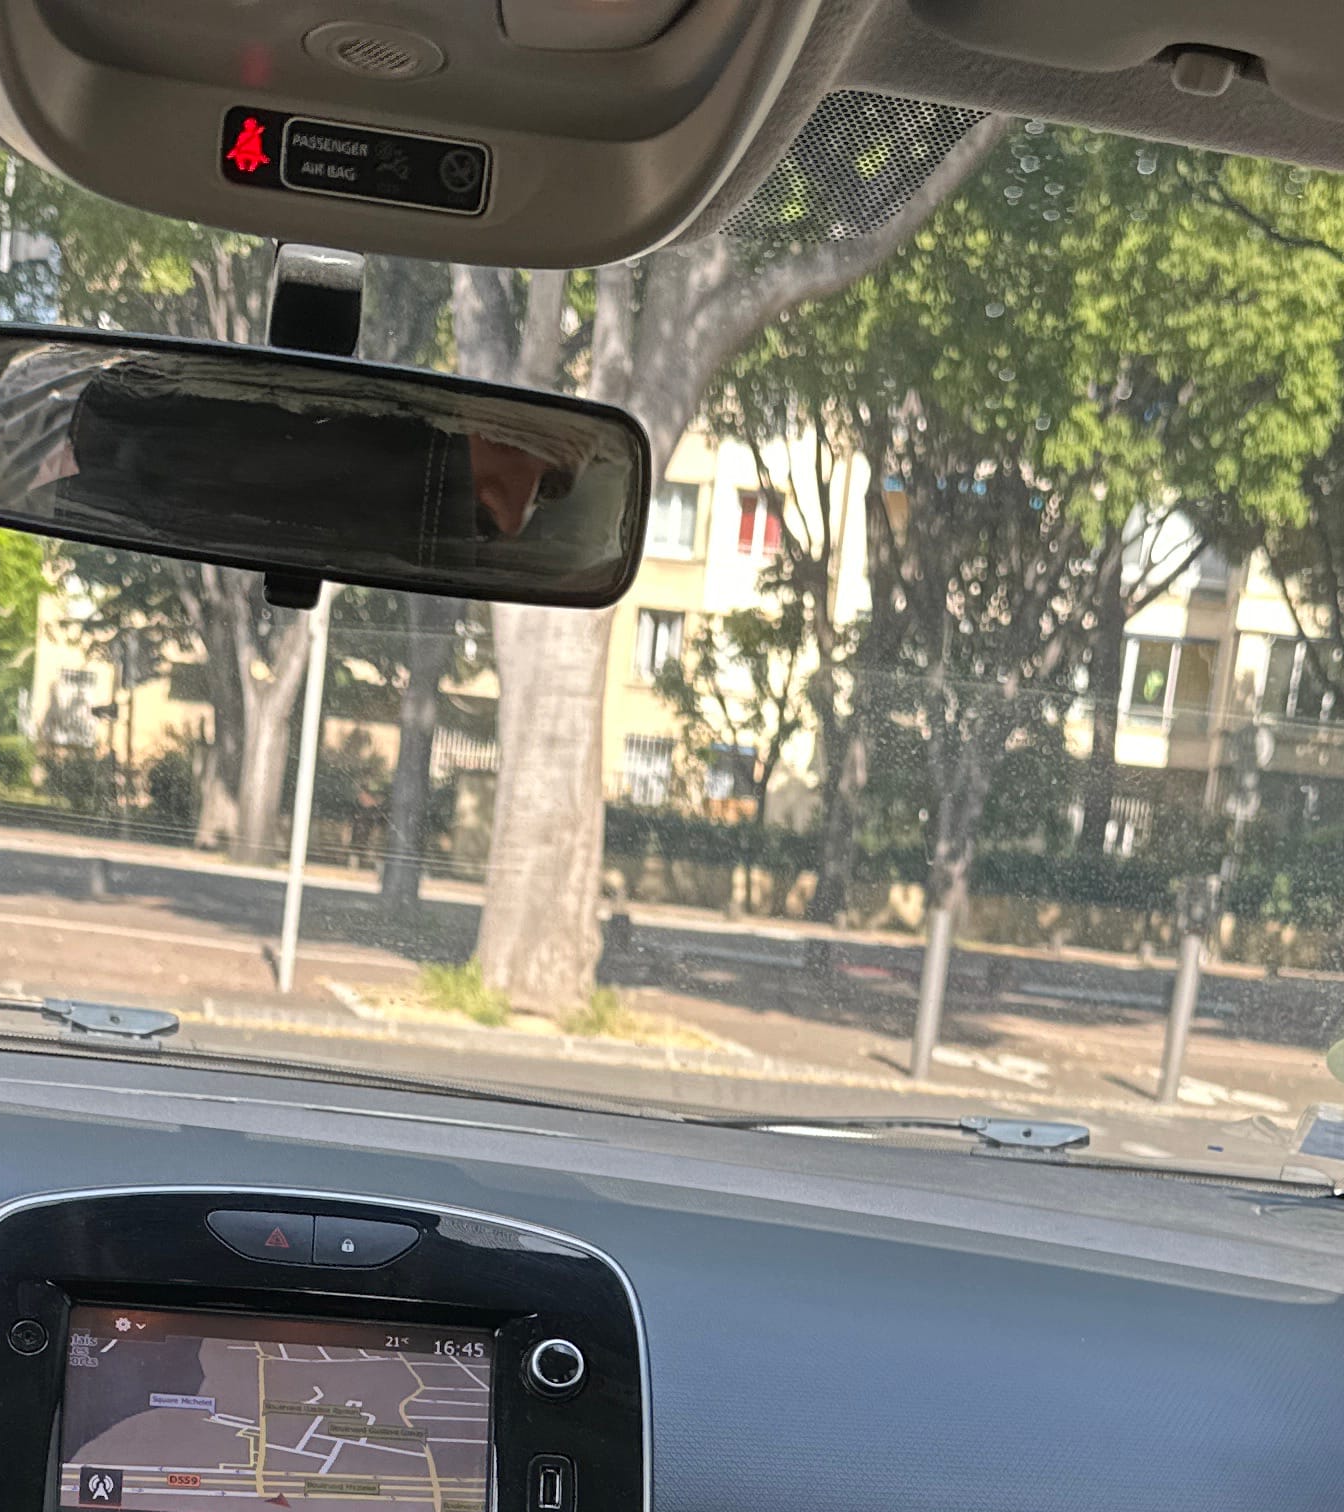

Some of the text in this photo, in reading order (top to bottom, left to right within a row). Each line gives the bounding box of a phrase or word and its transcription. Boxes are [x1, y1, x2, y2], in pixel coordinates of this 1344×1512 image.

[292, 133, 368, 157] PASSENGER
[301, 161, 356, 181] AIR BAG
[433, 1340, 485, 1358] 16:45
[152, 1395, 213, 1407] Square Michelet
